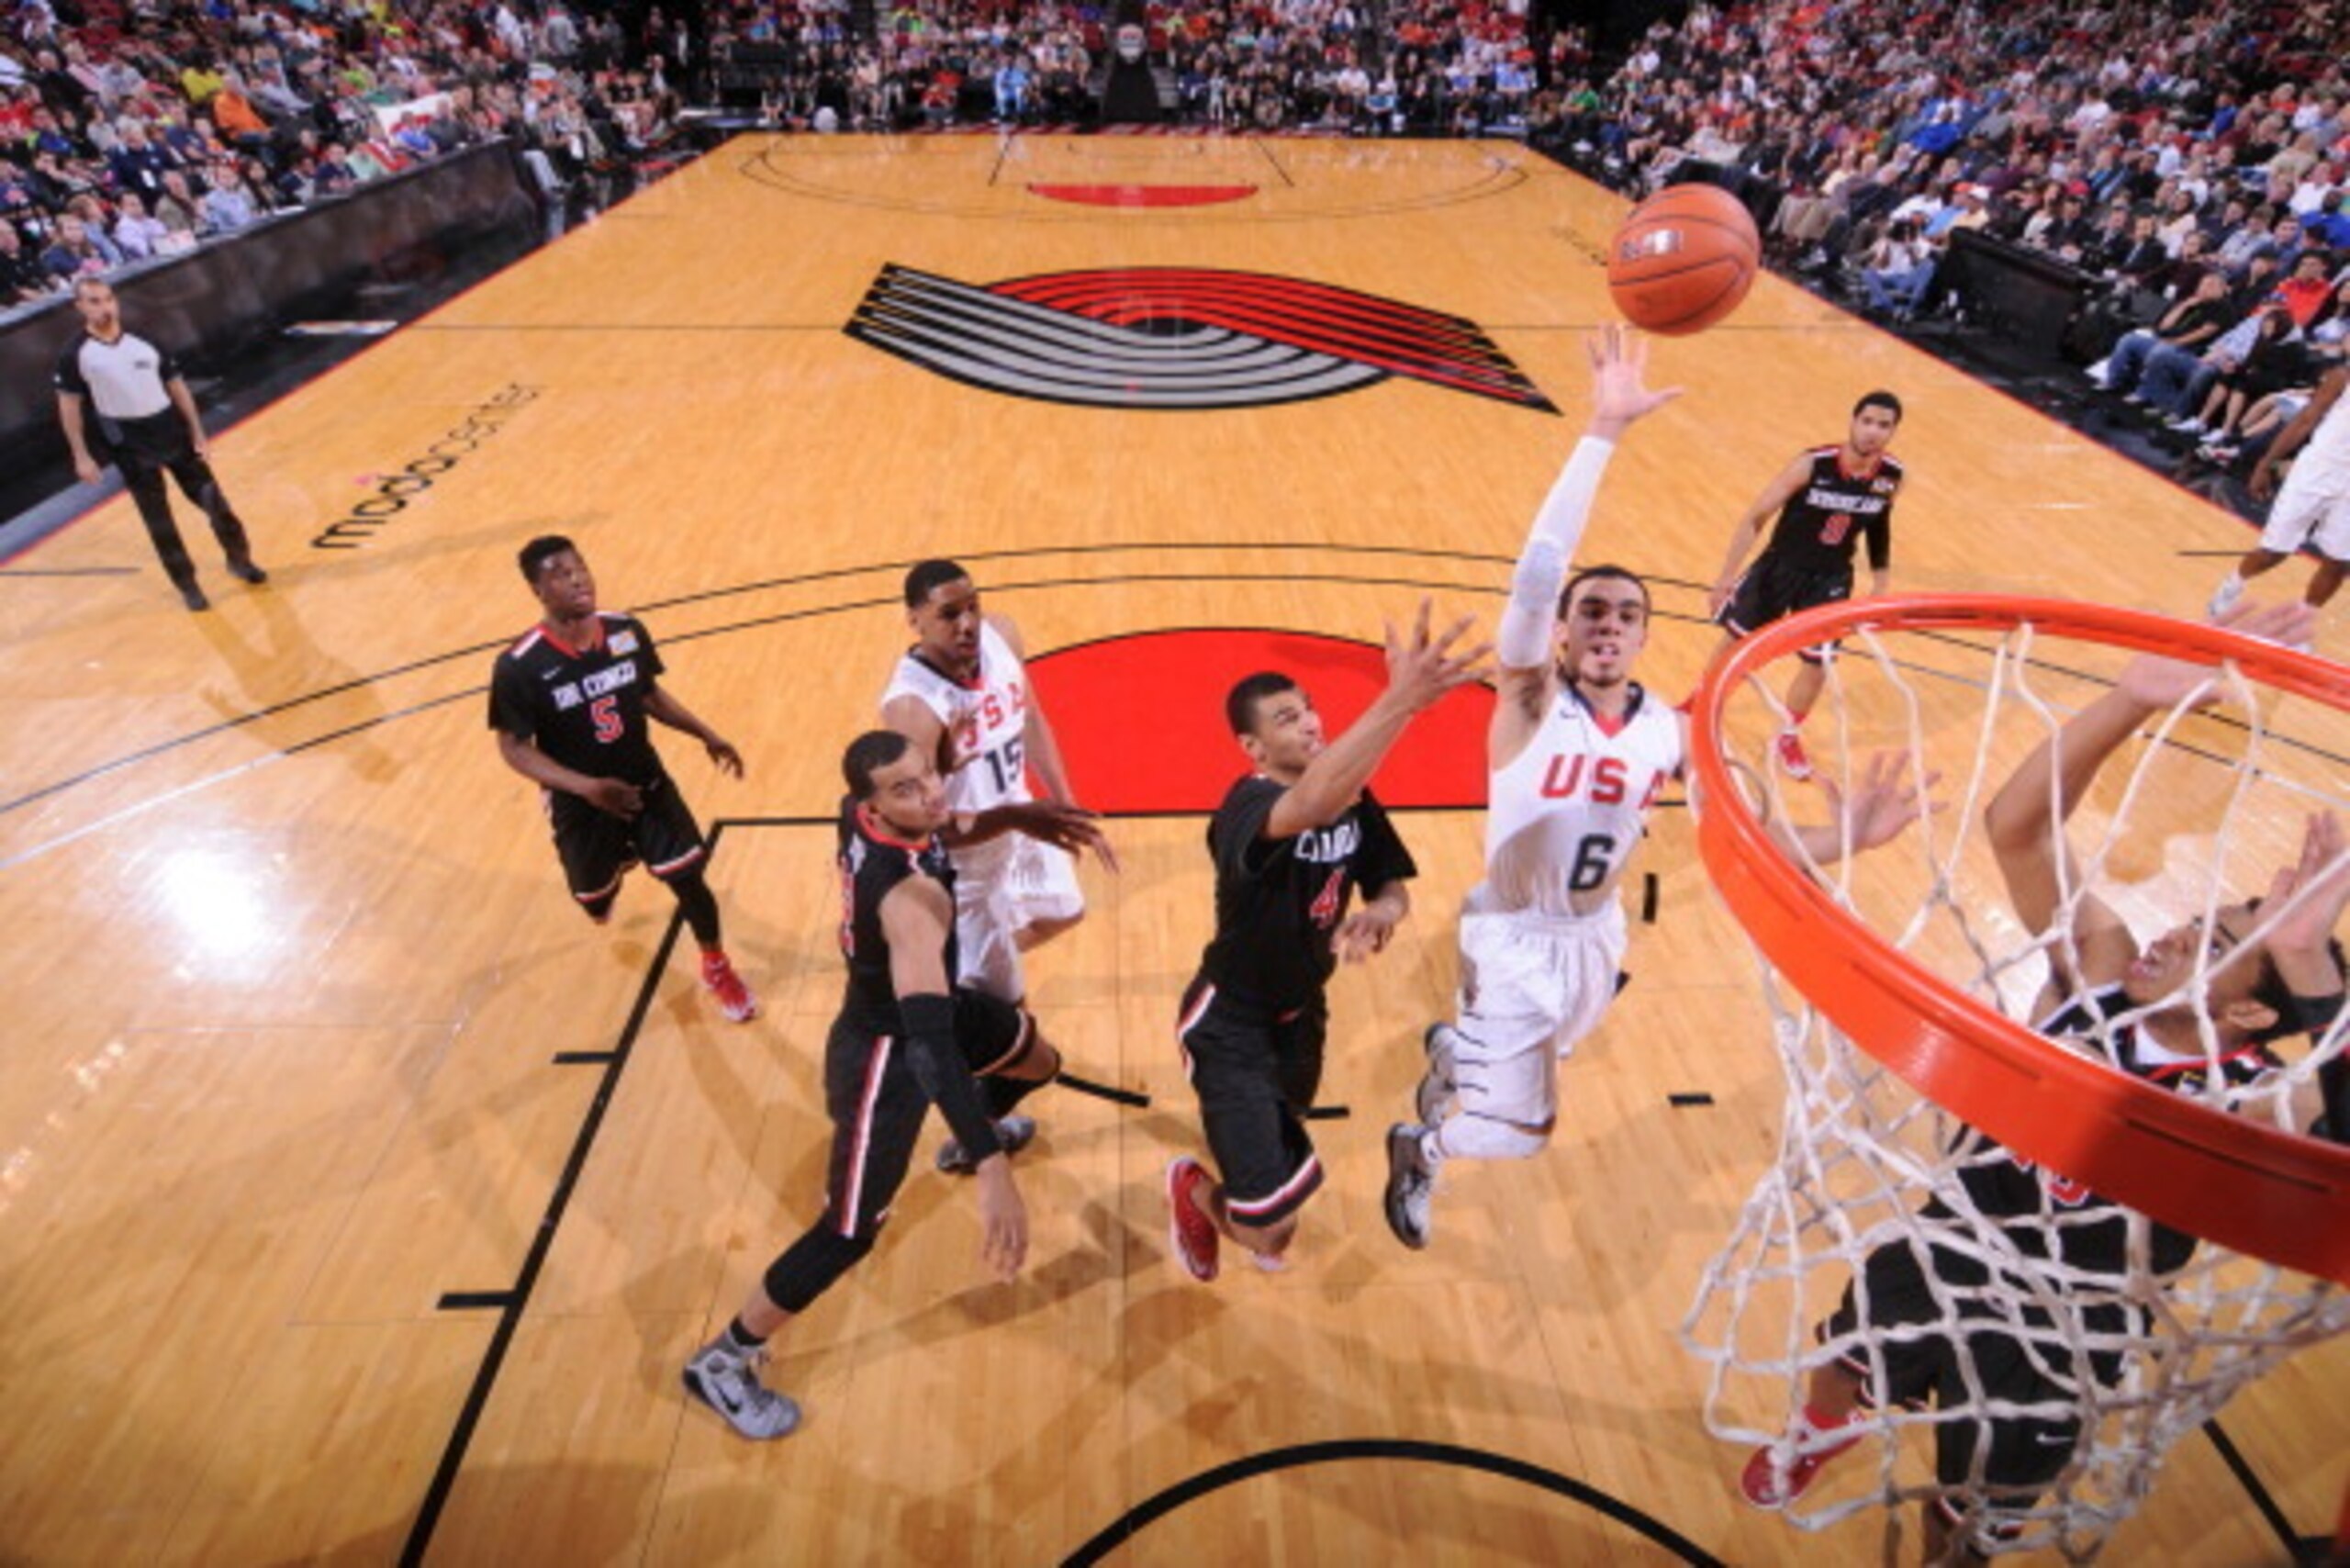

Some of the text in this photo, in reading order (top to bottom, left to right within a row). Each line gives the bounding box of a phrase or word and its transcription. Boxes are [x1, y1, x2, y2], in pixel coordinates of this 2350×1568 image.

[591, 695, 624, 744] 5
[1568, 833, 1616, 891] 6
[1310, 866, 1347, 929] 4
